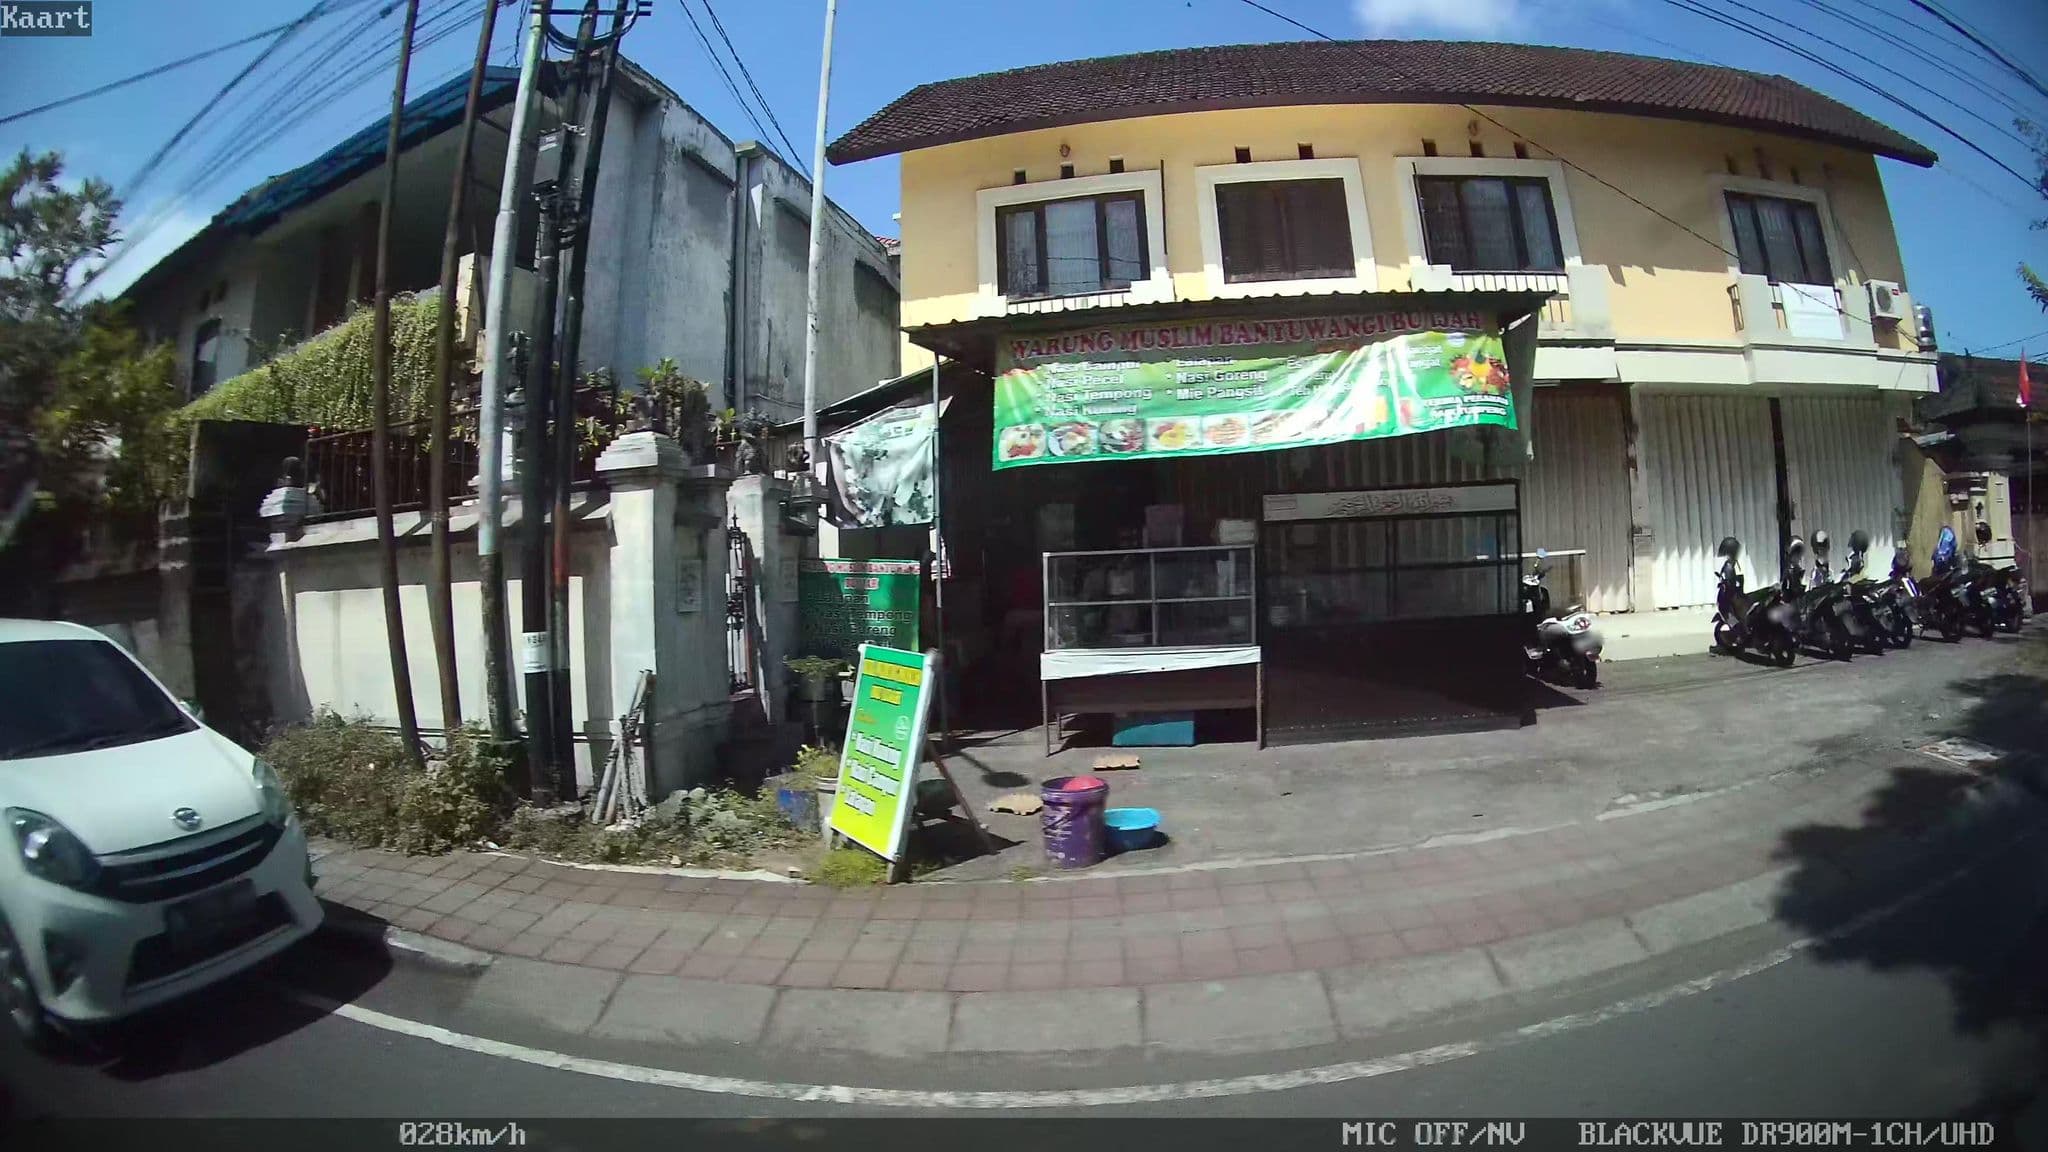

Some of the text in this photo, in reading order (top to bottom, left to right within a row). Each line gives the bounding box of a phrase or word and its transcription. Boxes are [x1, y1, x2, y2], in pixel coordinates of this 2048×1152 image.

[1009, 330, 1114, 359] WARUNG
[1120, 325, 1213, 351] MUSLIM
[1220, 312, 1386, 346] BANYUWANGI
[1082, 374, 1124, 386] Pecel
[1176, 369, 1269, 384] Nasi Goreng
[1082, 388, 1152, 402] Tempong
[1176, 384, 1265, 400] Mie Pangsit
